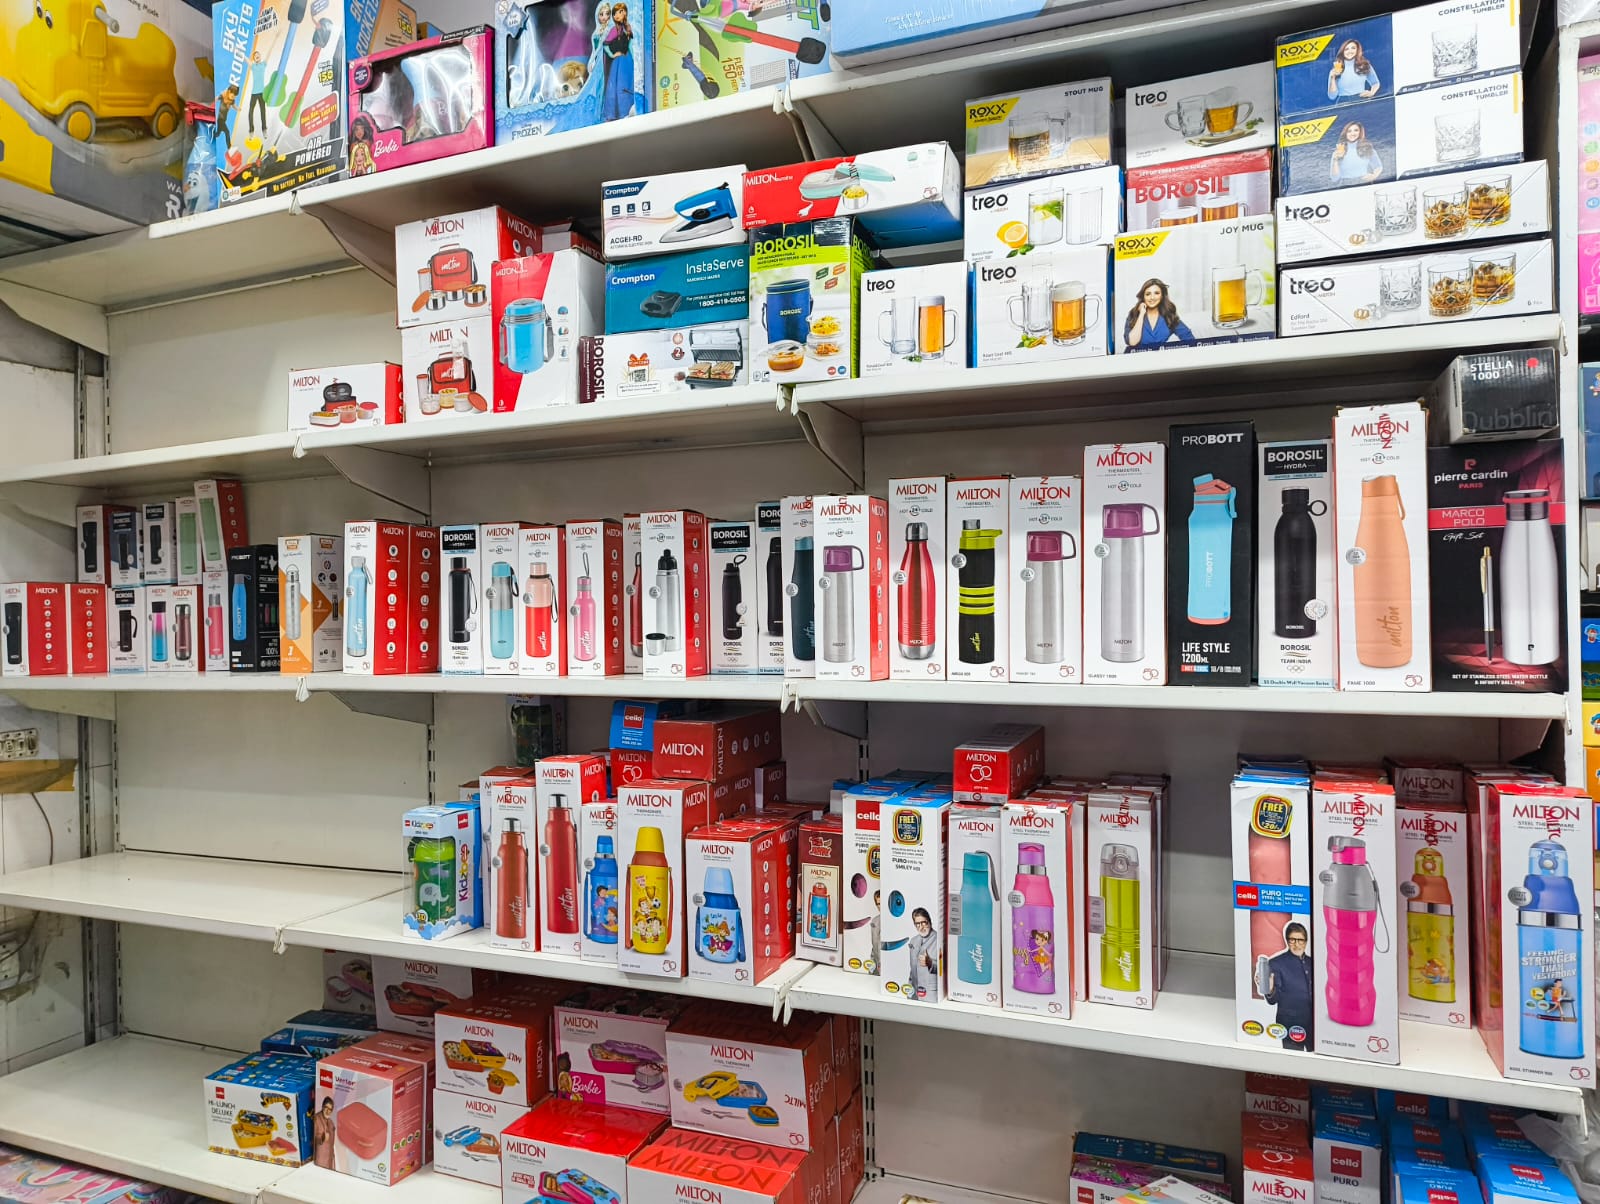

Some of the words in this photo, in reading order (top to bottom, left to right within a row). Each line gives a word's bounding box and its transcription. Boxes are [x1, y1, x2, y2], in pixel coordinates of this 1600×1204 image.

[1472, 4, 1505, 15] TUMBLER
[223, 11, 239, 53] SKY
[229, 3, 253, 86] ROCKETS
[1280, 41, 1319, 58] ROXX
[721, 58, 737, 78] 150
[1064, 88, 1086, 96] STOUT
[1135, 91, 1167, 106] treo
[1441, 84, 1508, 101] CONSTELLATION
[1476, 90, 1508, 100] TUMBLER
[969, 103, 1008, 119] ROXX
[511, 124, 543, 140] FROZEN
[1283, 122, 1321, 139] ROXX
[307, 136, 321, 149] AIR
[374, 140, 399, 158] Barbie
[295, 146, 331, 166] POWERED
[745, 174, 777, 187] MILTON
[604, 186, 640, 196] Crompton
[1135, 176, 1229, 203] BOROSIL
[972, 194, 1008, 211] treo
[1285, 204, 1330, 221] treo
[507, 217, 537, 241] MILTON
[1220, 225, 1239, 235] JOY
[1241, 223, 1264, 232] MUG
[754, 234, 819, 255] BOROSIL
[1118, 236, 1157, 251] ROXX
[496, 268, 518, 276] MILTON
[687, 259, 744, 274] InstaServe
[612, 273, 655, 285] Crompton
[982, 266, 1017, 281] treo
[867, 279, 895, 291] treo
[1290, 278, 1335, 295] treo
[594, 338, 604, 398] BOROSIL
[1470, 361, 1514, 372] STELLA
[293, 376, 320, 386] MILTON
[1472, 372, 1500, 380] 1000
[1464, 403, 1552, 430] Dubblin
[1352, 420, 1409, 437] MILTON
[1182, 433, 1244, 445] PROBOTT
[1097, 451, 1152, 467] MILTON
[1268, 450, 1323, 462] BOROSIL
[1434, 473, 1468, 484] pierre
[1471, 470, 1508, 480] cardin
[896, 484, 936, 494] MILTON
[957, 488, 1000, 500] MILTON
[1020, 486, 1070, 500] MILTON
[820, 504, 861, 516] MILTON
[1442, 509, 1484, 518] MARCO
[647, 515, 676, 524] MILTON
[1454, 518, 1484, 526] POLO
[349, 526, 370, 534] MILTON
[383, 527, 404, 536] MILTON
[416, 530, 436, 538] MILTON
[444, 532, 474, 541] BOROSIL
[486, 528, 514, 536] MILTON
[571, 528, 597, 536] MILTON
[606, 528, 622, 536] MILTON
[713, 530, 748, 539] BOROSIL
[526, 533, 550, 542] MILTON
[1443, 533, 1463, 542] Gift
[1464, 532, 1486, 540] Set
[1383, 606, 1403, 648] milton
[1182, 642, 1200, 652] LIFE
[1203, 643, 1230, 653] STYLE
[660, 744, 704, 755] MILTON
[619, 753, 646, 762] MILTON
[966, 754, 996, 762] MILTON
[542, 768, 574, 778] MILTON
[584, 763, 604, 776] MILTON
[734, 776, 752, 790] MILTON
[1402, 775, 1454, 790] MILTON
[627, 794, 672, 807] MILTON
[685, 791, 706, 807] MILTON
[1263, 802, 1283, 812] FREE
[1324, 801, 1383, 816] MILTON
[1513, 804, 1580, 820] MILTON
[1100, 814, 1138, 824] MILTON
[1352, 794, 1365, 836] MILTON
[958, 822, 994, 832] MILTON
[1009, 816, 1054, 829] MILTON
[1401, 818, 1456, 833] MILTON
[701, 845, 734, 854] MILTON
[757, 838, 773, 852] MILTON
[1521, 953, 1576, 967] STRONGER
[404, 961, 438, 975] MILTON
[1541, 964, 1563, 972] THAN
[564, 1016, 598, 1029] MILTON
[464, 1025, 494, 1037] MILTON
[711, 1045, 754, 1061] MILTON
[571, 1076, 601, 1094] Barbie
[466, 1100, 496, 1113] MILTON
[1253, 1100, 1301, 1113] MILTON
[1397, 1105, 1427, 1114] cello
[506, 1141, 545, 1158] MILTON
[664, 1134, 794, 1168] MILTON
[1332, 1158, 1358, 1167] cello
[640, 1150, 776, 1190] MILTON
[1334, 1176, 1359, 1186] PURO
[675, 1184, 721, 1204] MILTON
[1252, 1180, 1305, 1200] MILTON
